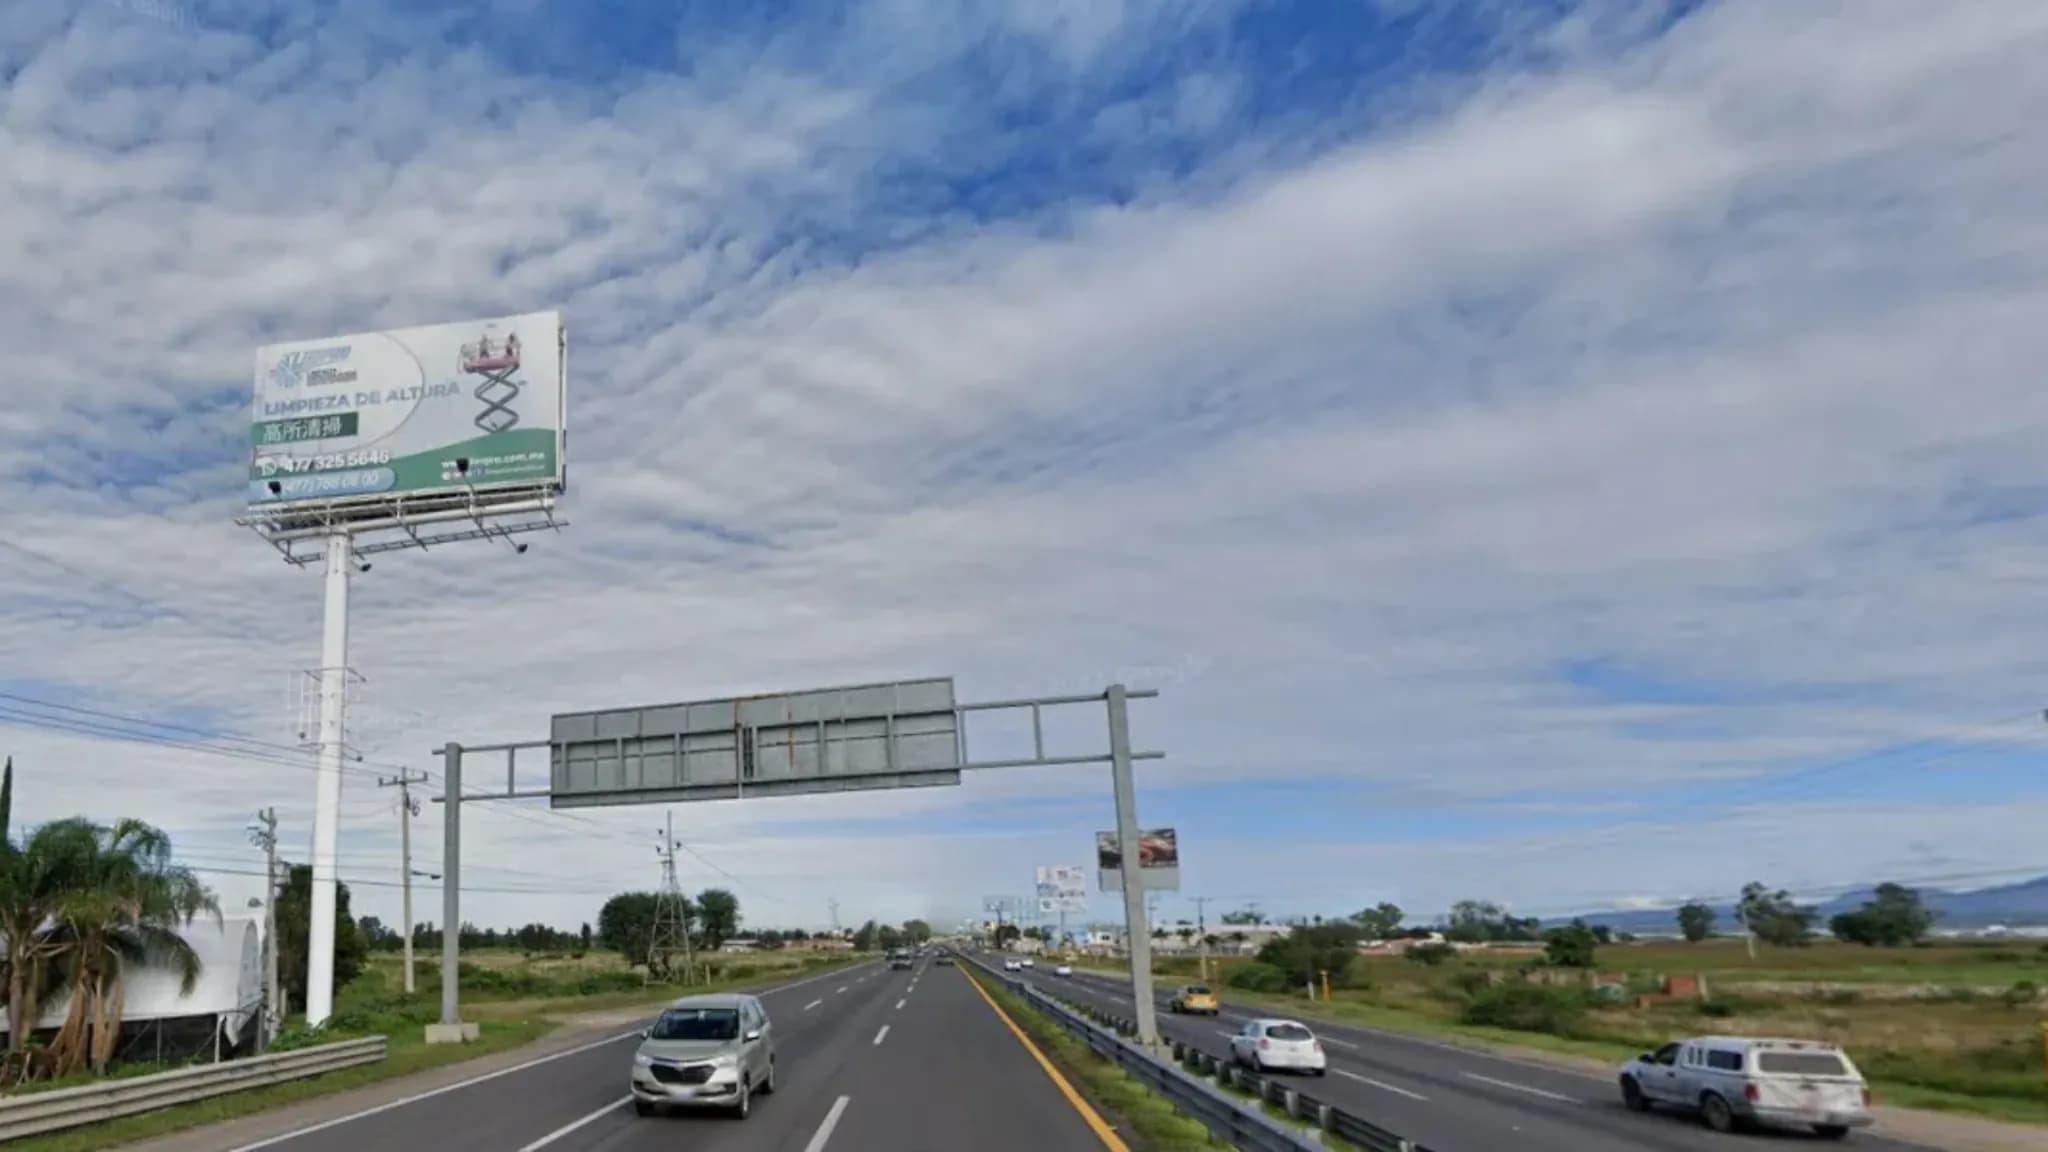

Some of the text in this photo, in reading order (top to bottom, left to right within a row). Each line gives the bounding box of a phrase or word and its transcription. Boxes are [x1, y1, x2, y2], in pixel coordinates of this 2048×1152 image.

[264, 381, 460, 415] LIMPIEZA DE ALTURA
[314, 453, 345, 469] 325
[348, 449, 390, 466] 5646
